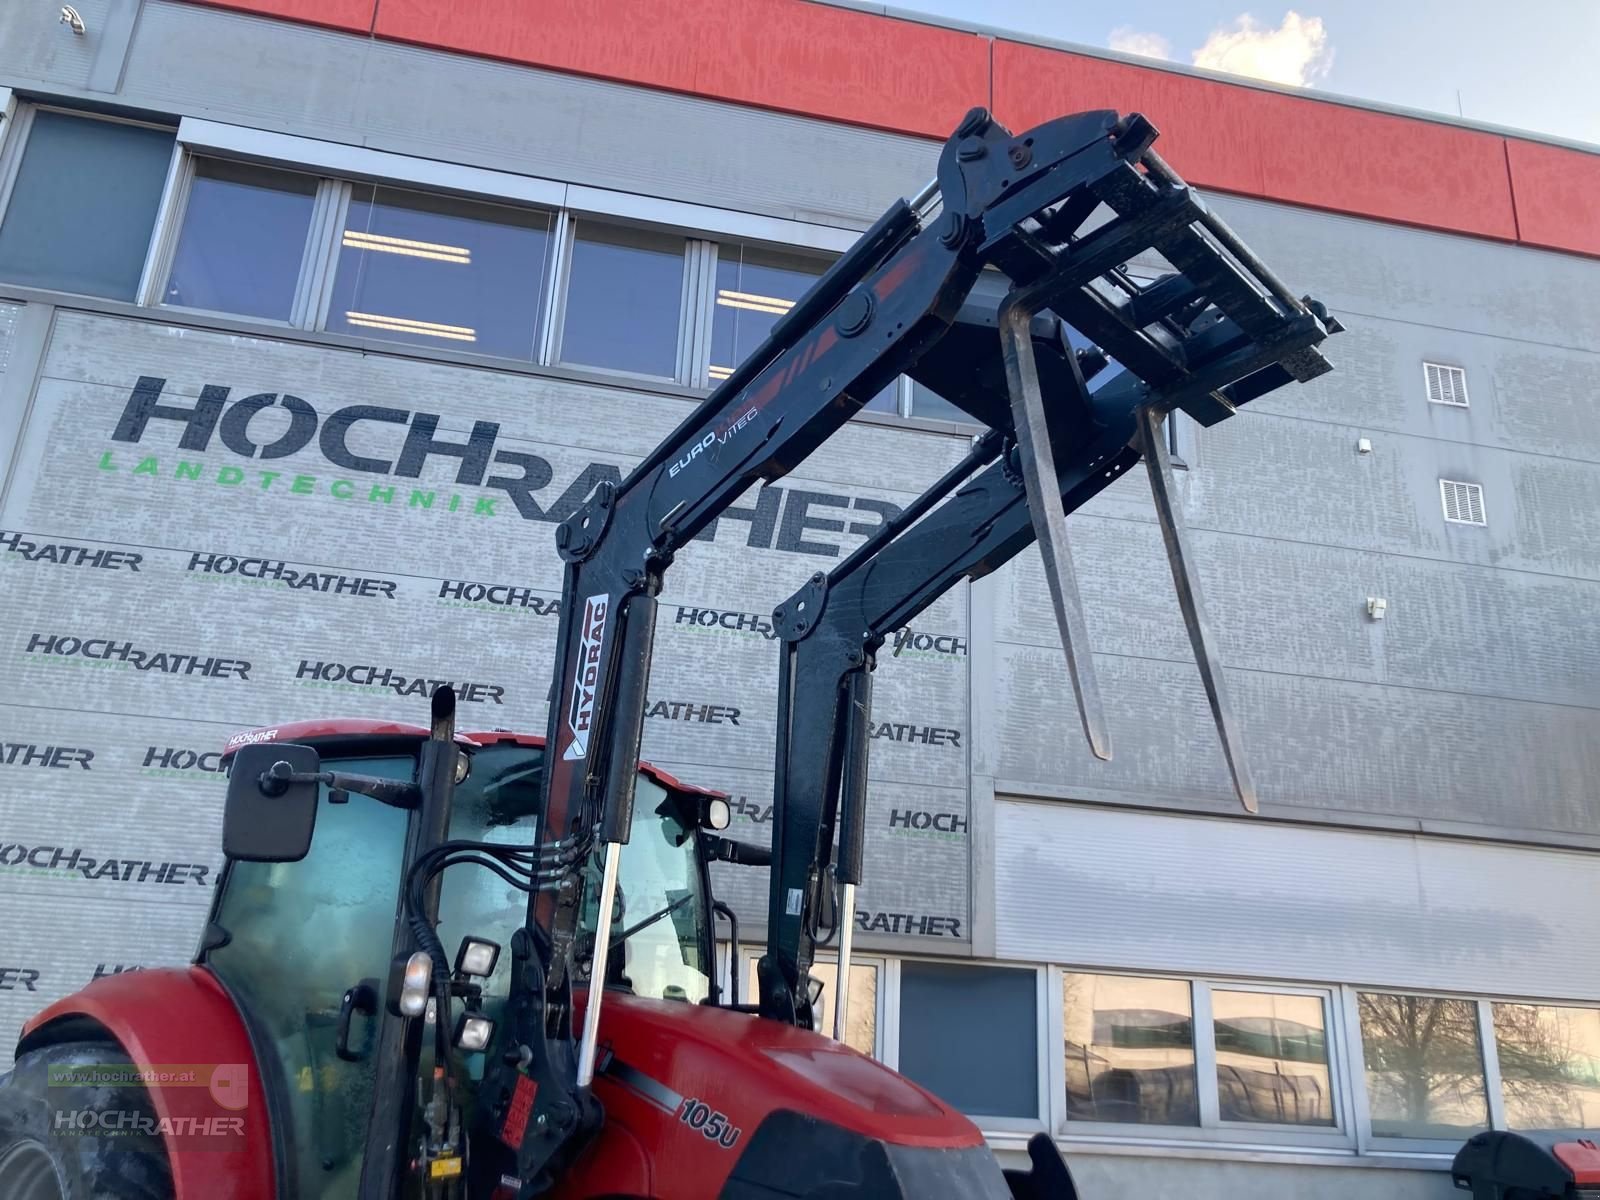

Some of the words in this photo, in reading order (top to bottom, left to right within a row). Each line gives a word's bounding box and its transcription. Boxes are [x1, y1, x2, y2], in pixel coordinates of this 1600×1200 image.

[669, 431, 716, 479] EURO
[98, 451, 498, 518] LANDTECHNIK
[187, 553, 398, 600] HOCHRATHER
[25, 633, 252, 681] HOCHRATHER
[577, 601, 607, 731] HYDRAC
[228, 729, 279, 747] HOCHRATHER
[0, 843, 210, 887] OCHRATHER
[679, 1097, 742, 1149] 105U
